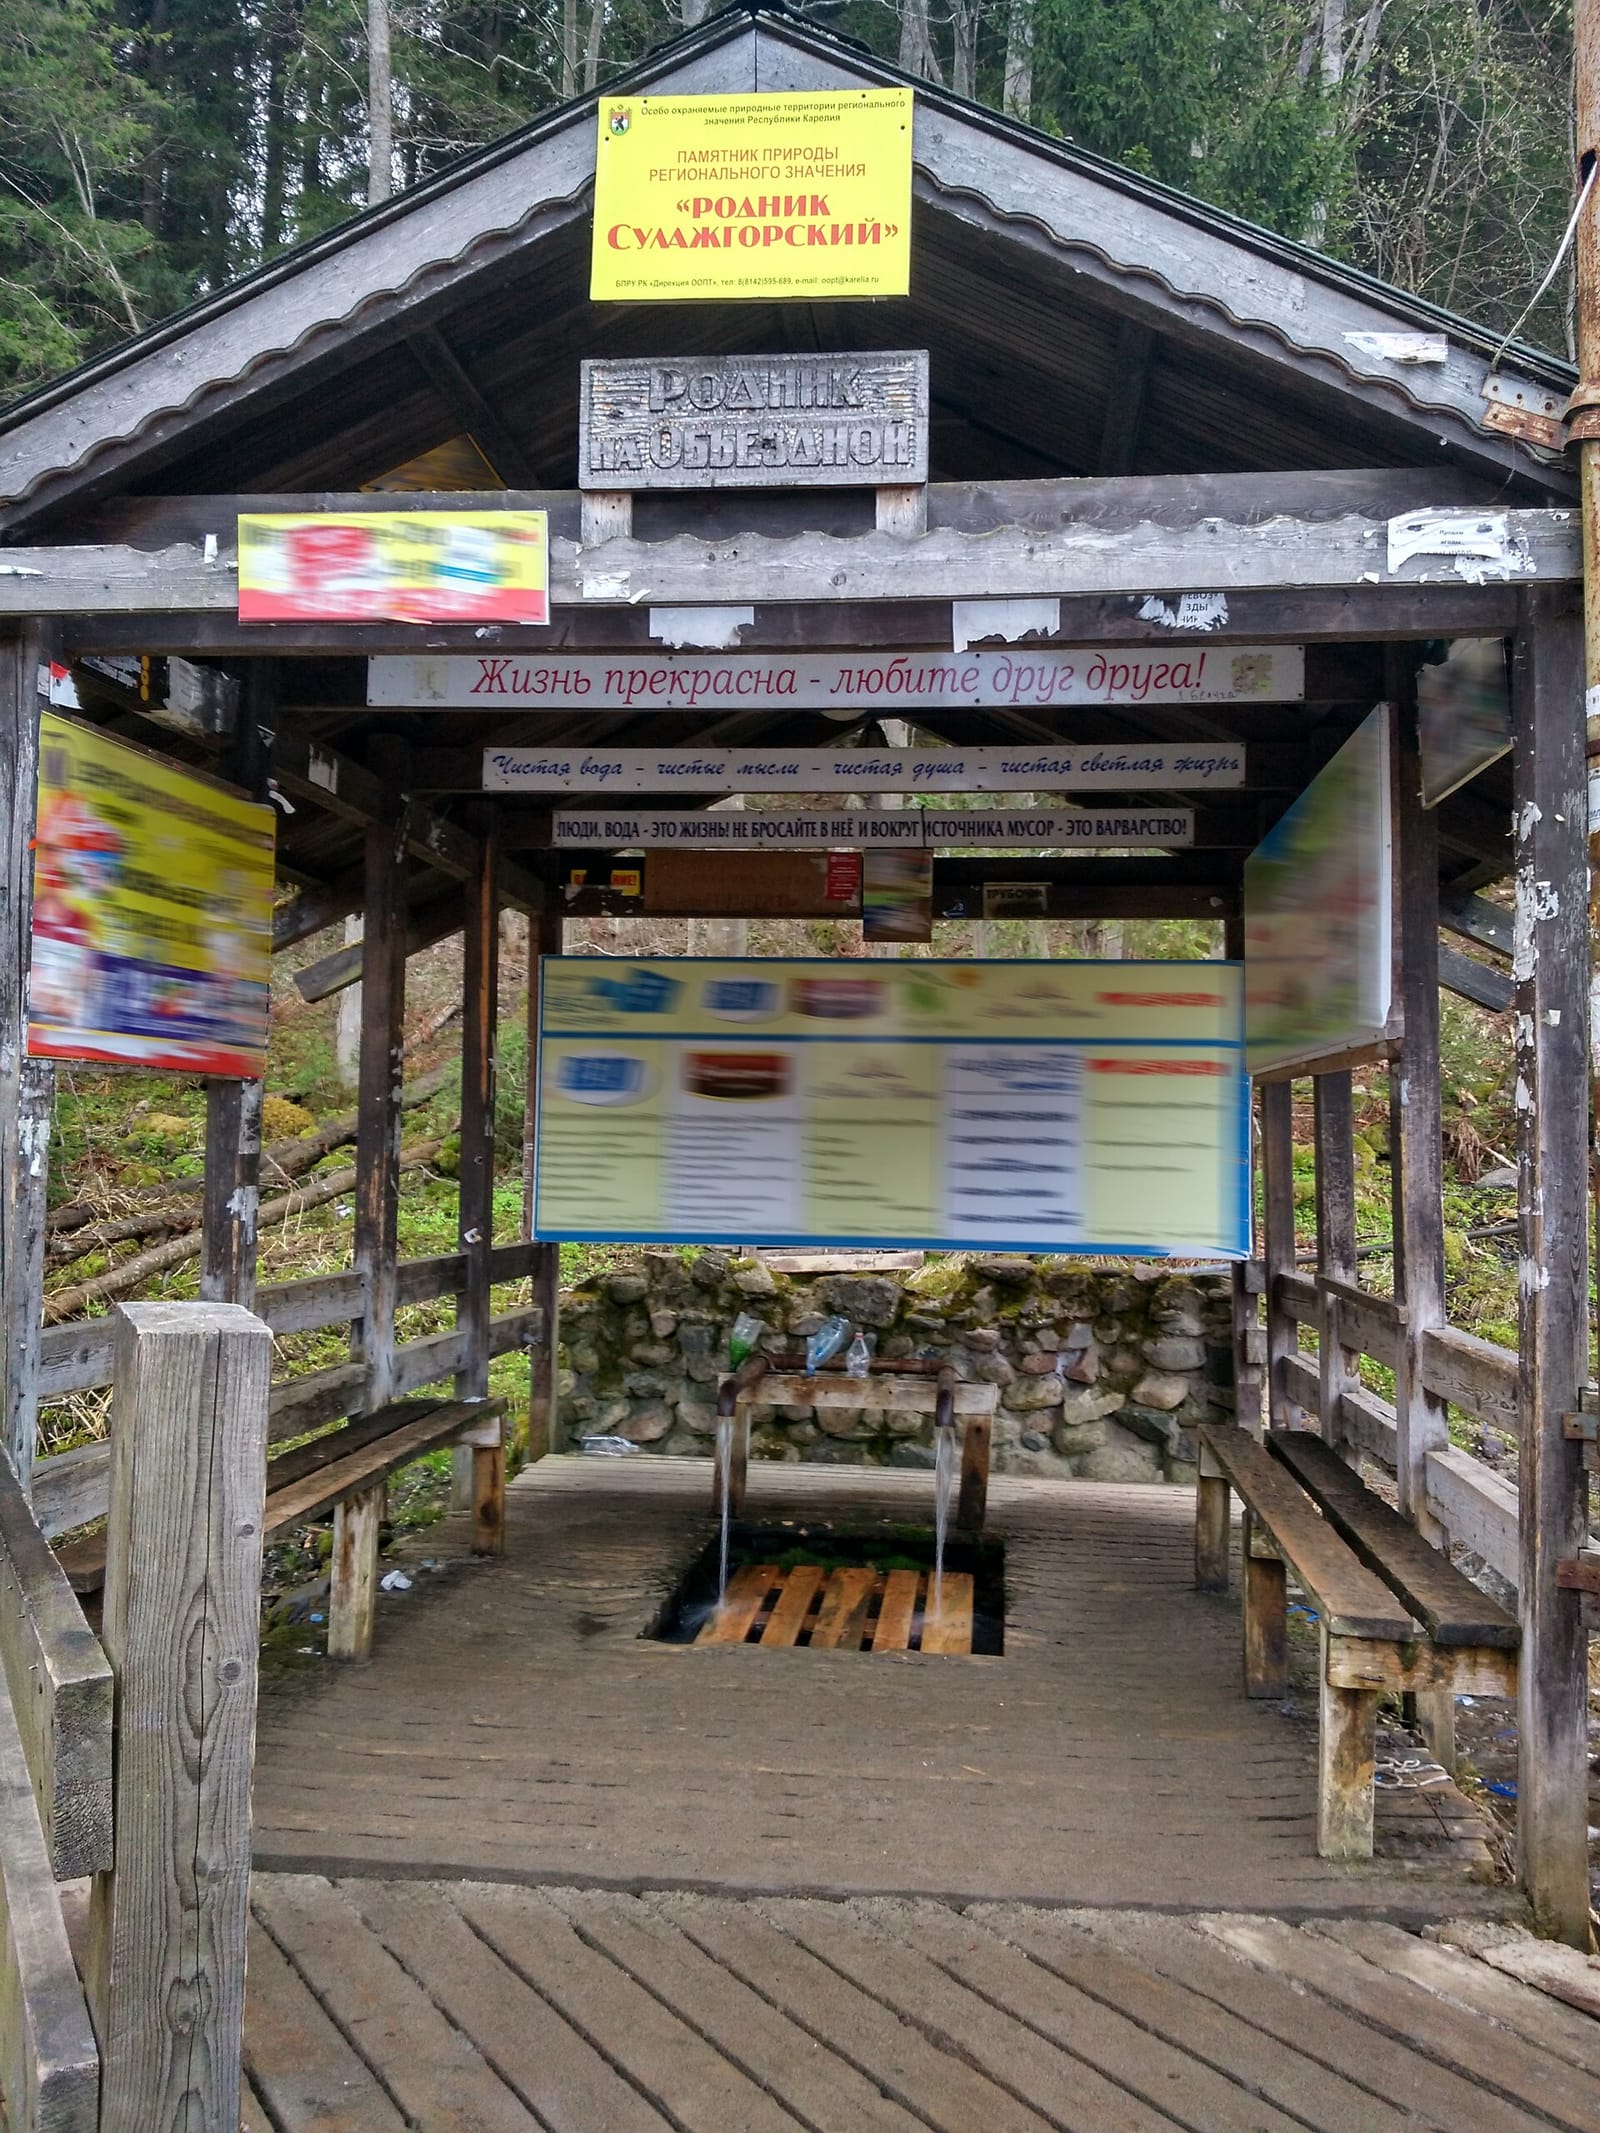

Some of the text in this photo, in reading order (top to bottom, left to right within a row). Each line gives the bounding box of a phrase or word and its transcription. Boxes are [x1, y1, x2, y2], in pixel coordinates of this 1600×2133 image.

[641, 100, 906, 118] Особо охраняемые природные территории регионального
[704, 114, 841, 126] значения Республики Карелия
[677, 147, 839, 164] ПАМЯТНИК ПРИРОДЫ
[649, 163, 866, 182] РЕГИОНАЛЬНОГО ЗНАЧЕНИЯ
[677, 194, 831, 219] «РОДНИК
[650, 366, 864, 412] РОДНИК
[470, 658, 591, 695] Жизнь
[604, 667, 798, 705] прекрасна
[829, 656, 979, 695] любите
[992, 655, 1075, 703] друг
[1086, 652, 1207, 702] друга!
[492, 755, 571, 777] Чистая
[580, 756, 622, 782] вода
[657, 759, 726, 776] чистые
[736, 762, 800, 775] мысли
[833, 759, 903, 777] чистая
[912, 761, 965, 782] душа
[1001, 756, 1073, 775] чистая
[1079, 752, 1166, 774] светлая
[1173, 756, 1239, 778] жизнь
[605, 821, 640, 841] ВОДА
[651, 821, 677, 838] ЭТО
[679, 821, 729, 838] ЖИЗНЬ!
[732, 821, 748, 838] НЕ
[751, 818, 817, 838] БРОСАЙТЕ
[820, 821, 829, 838] В
[832, 818, 854, 838] НЕЁ
[859, 821, 868, 838] И
[871, 821, 920, 838] ВОКРУГ
[924, 820, 1004, 838] ИСТОЧНИКА
[1007, 820, 1055, 837] МУСОР
[1066, 819, 1093, 836] ЭТО
[1096, 818, 1187, 836] ВАРВАРСТВО!
